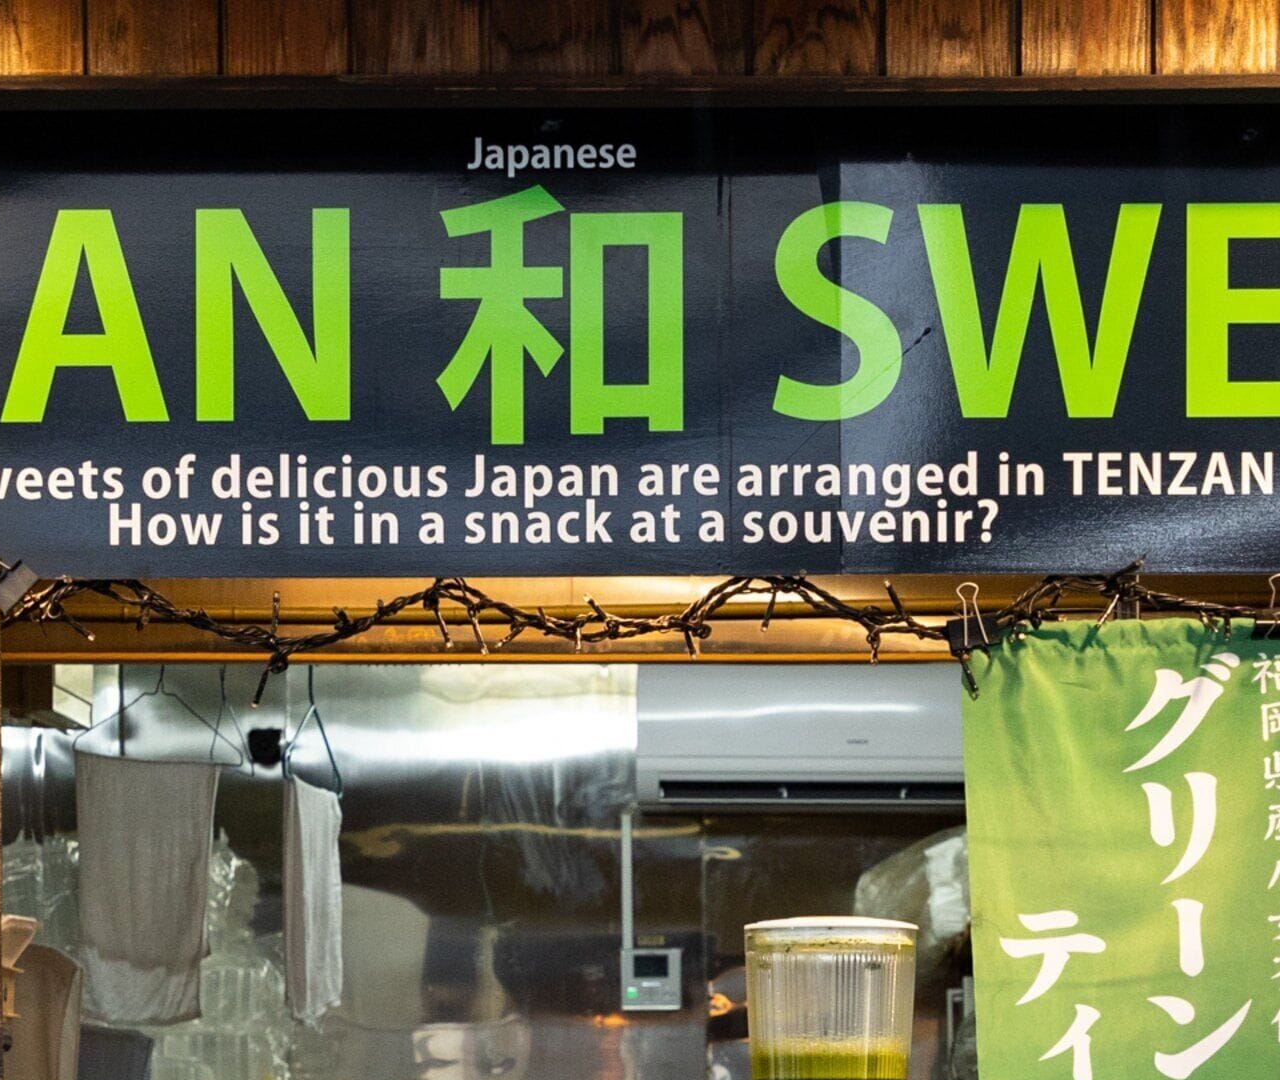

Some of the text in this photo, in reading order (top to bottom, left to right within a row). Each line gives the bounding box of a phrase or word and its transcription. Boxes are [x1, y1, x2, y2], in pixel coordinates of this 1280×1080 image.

[467, 138, 636, 177] Japanese
[437, 184, 685, 446] 和
[142, 455, 197, 500] of
[218, 454, 449, 500] delicious
[465, 455, 619, 507] Japan
[638, 464, 721, 498] are
[737, 452, 979, 507] arranged
[997, 452, 1045, 497] in
[1063, 452, 1275, 497] TENZAN
[109, 499, 1000, 547] How is it in a snack at a souvenir?
[1123, 651, 1254, 1080] グリーン
